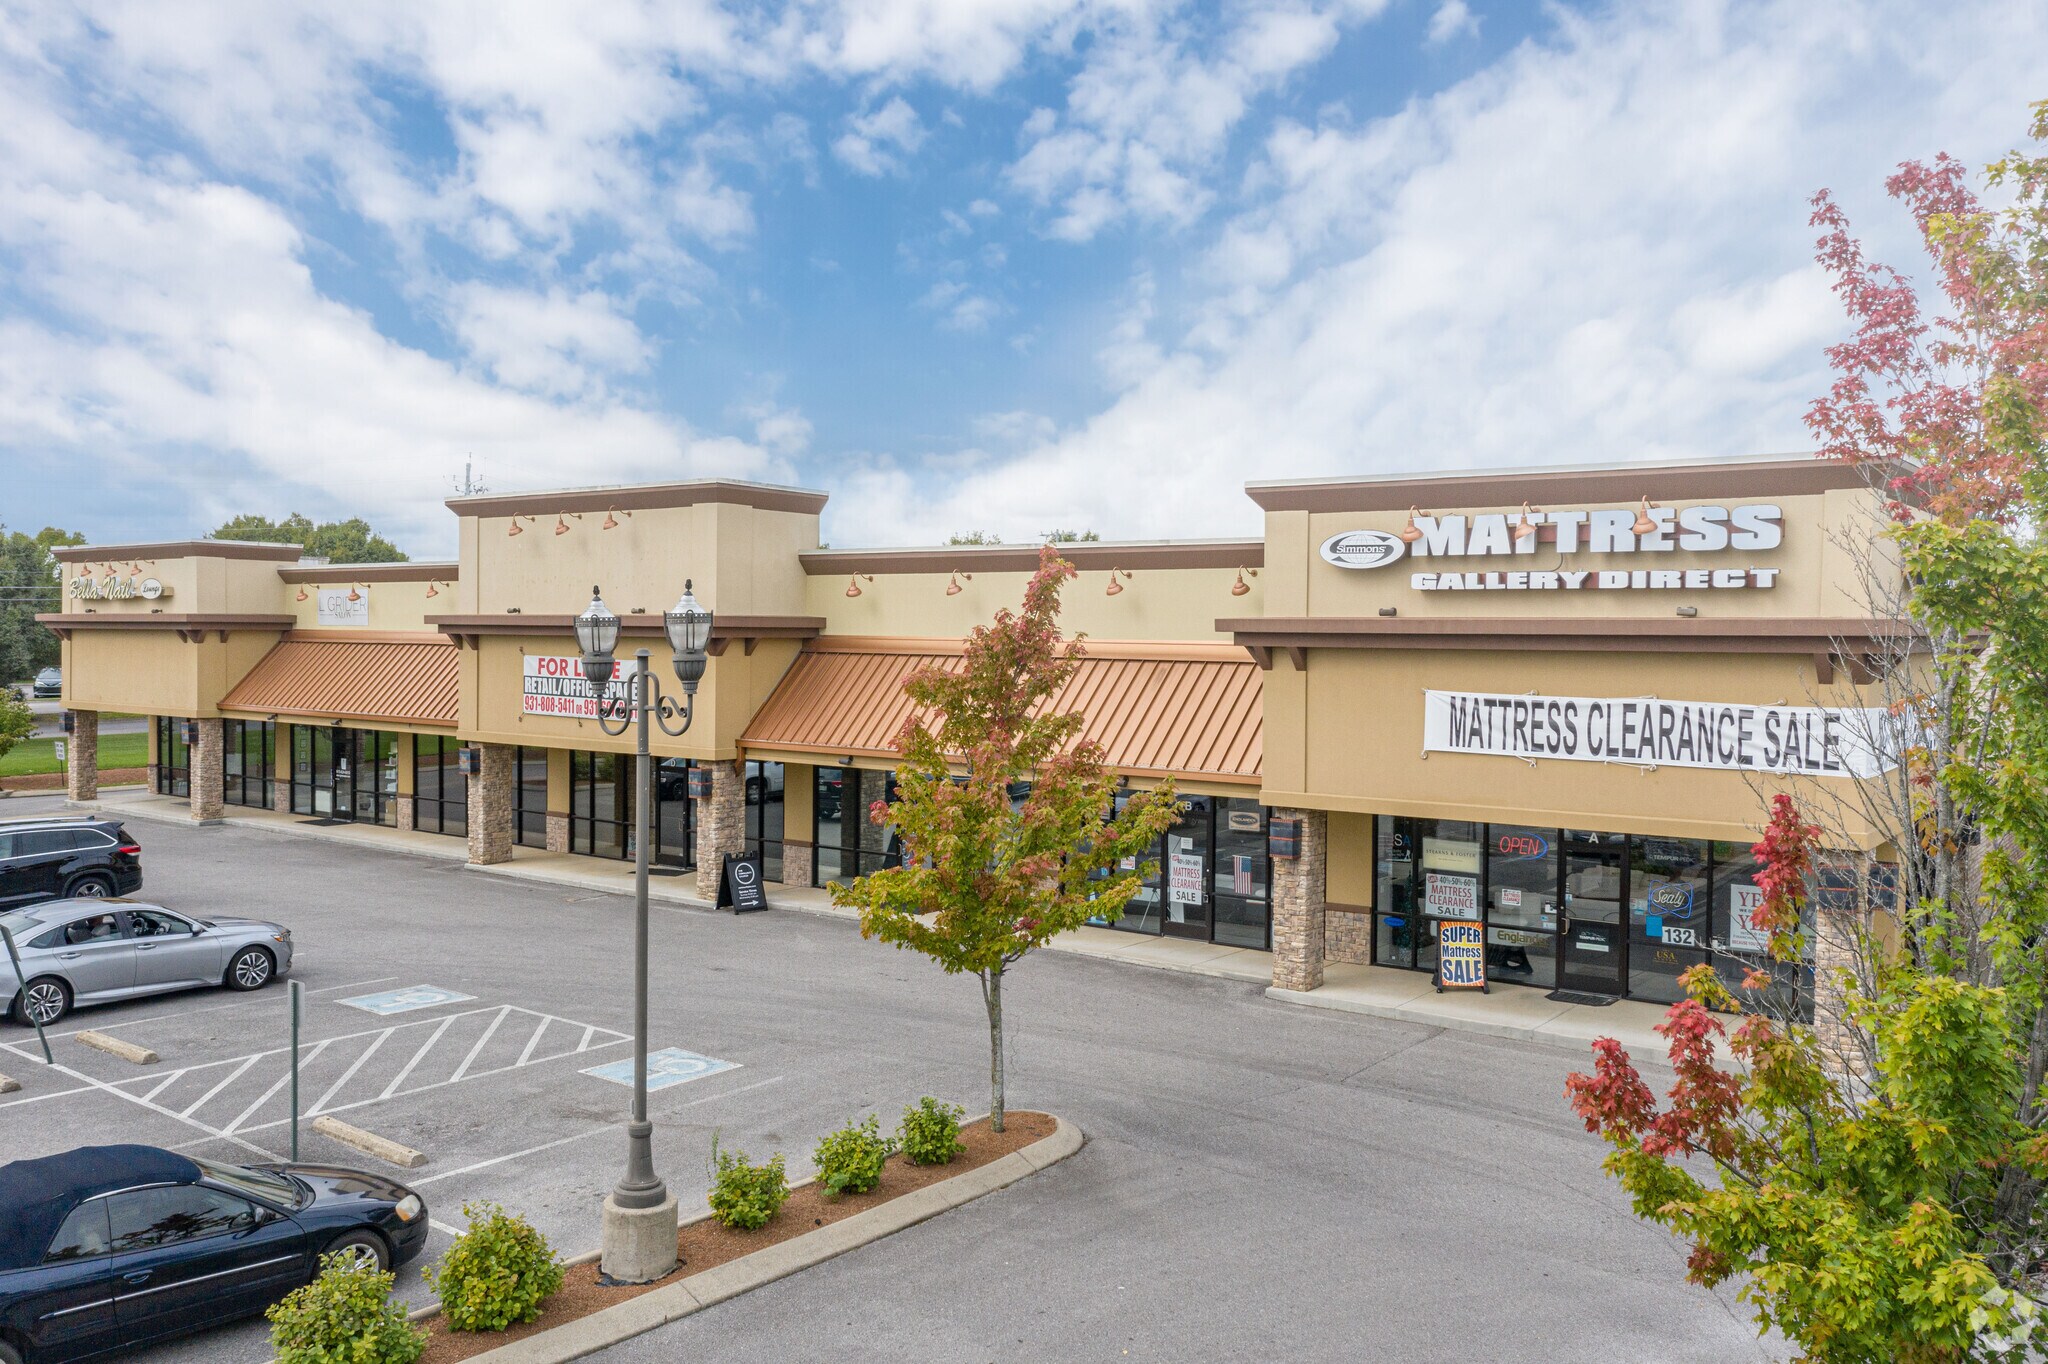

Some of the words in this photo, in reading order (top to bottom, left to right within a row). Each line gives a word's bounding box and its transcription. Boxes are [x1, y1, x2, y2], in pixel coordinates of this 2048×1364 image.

[1411, 504, 1783, 556] MATTRESS
[1336, 545, 1386, 553] Simmons
[1411, 570, 1592, 590] GALLERY
[1598, 568, 1781, 589] DIRECT
[69, 577, 98, 600] Bella
[102, 577, 133, 600] Nail
[142, 584, 160, 595] Lounge
[537, 657, 569, 677] FOR
[524, 676, 598, 698] RETAIL/OFFIC
[524, 695, 575, 714] 931-808-5411
[1449, 696, 1578, 756] MATTRESS
[1587, 701, 1755, 765] CLEARANCE
[1764, 710, 1841, 771] SALE
[1185, 801, 1192, 811] B
[1588, 832, 1599, 844] A
[1500, 836, 1540, 856] OPEN
[1173, 866, 1200, 879] MATTRESS
[1171, 877, 1201, 890] CLEARANCE
[1431, 884, 1472, 898] MATTRESS
[1176, 891, 1196, 902] SALE
[1429, 894, 1474, 909] CLEARANCE
[1653, 890, 1685, 907] Sealy
[1738, 892, 1762, 907] YE
[1437, 906, 1465, 917] SALE
[1442, 926, 1480, 943] SUPER
[1664, 928, 1692, 944] 132
[1442, 945, 1481, 958] Mattress
[1442, 959, 1482, 983] SALE
